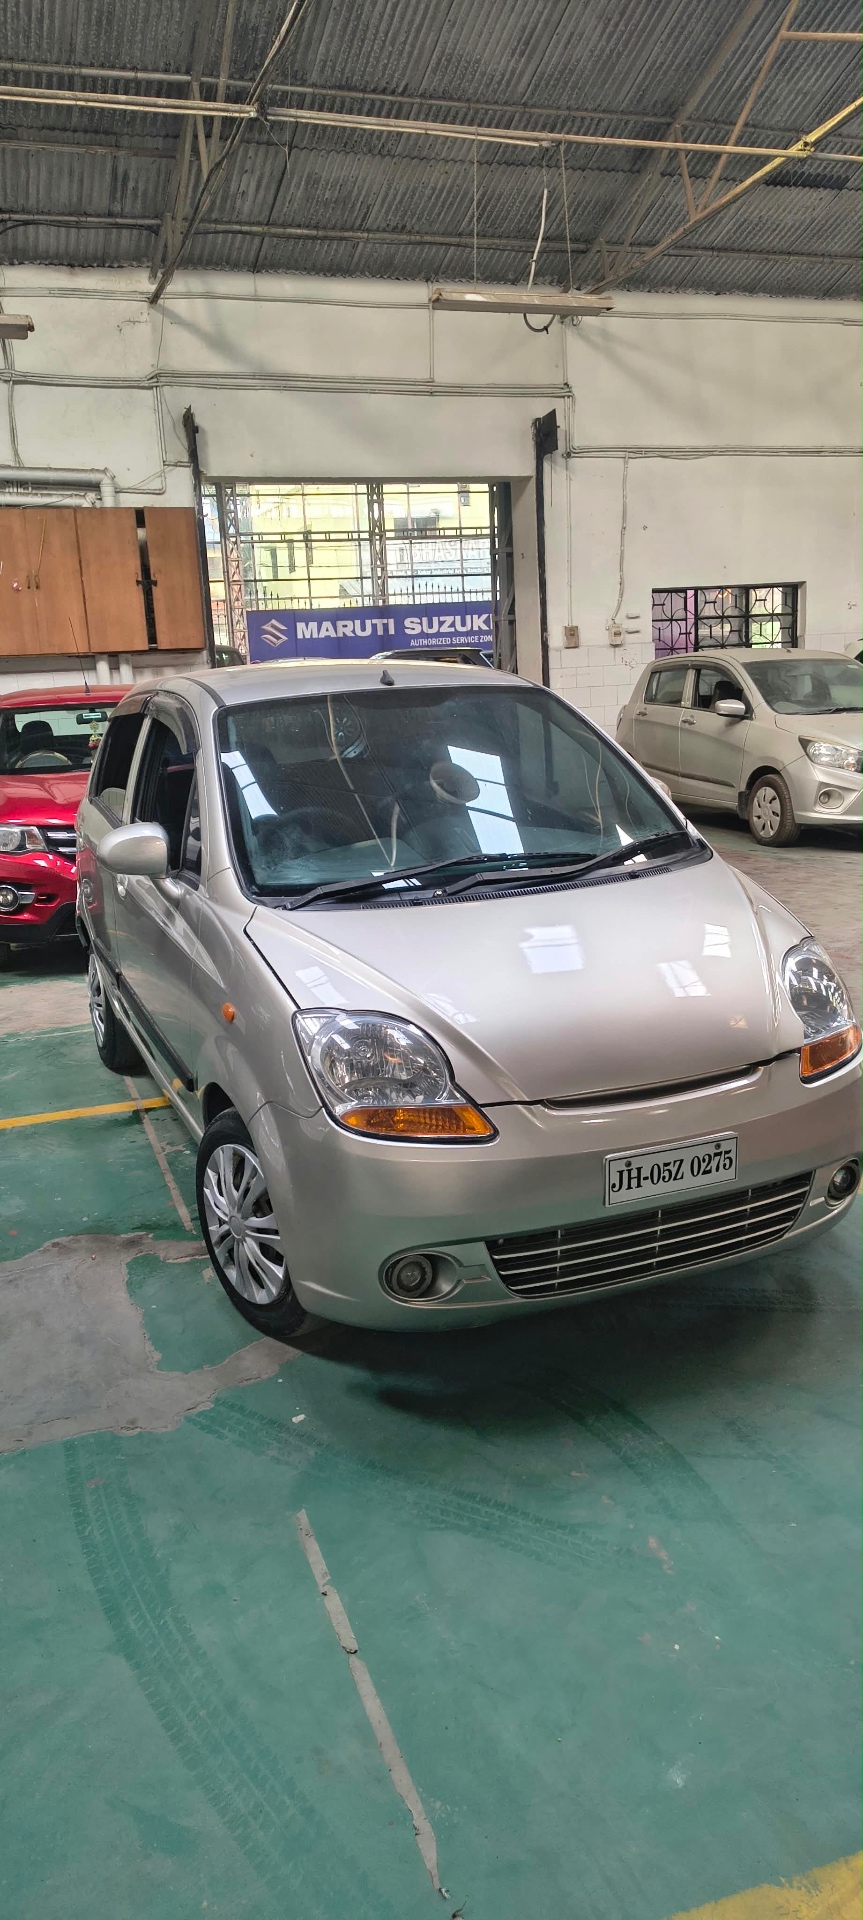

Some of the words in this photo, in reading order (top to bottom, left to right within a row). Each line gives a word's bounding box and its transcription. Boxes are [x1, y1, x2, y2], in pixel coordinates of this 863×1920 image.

[296, 618, 395, 639] MARUTI
[410, 637, 451, 647] AUTHORIZED
[452, 636, 479, 644] SERVICE
[611, 1159, 685, 1193] JH-05Z
[690, 1149, 734, 1178] 0275
